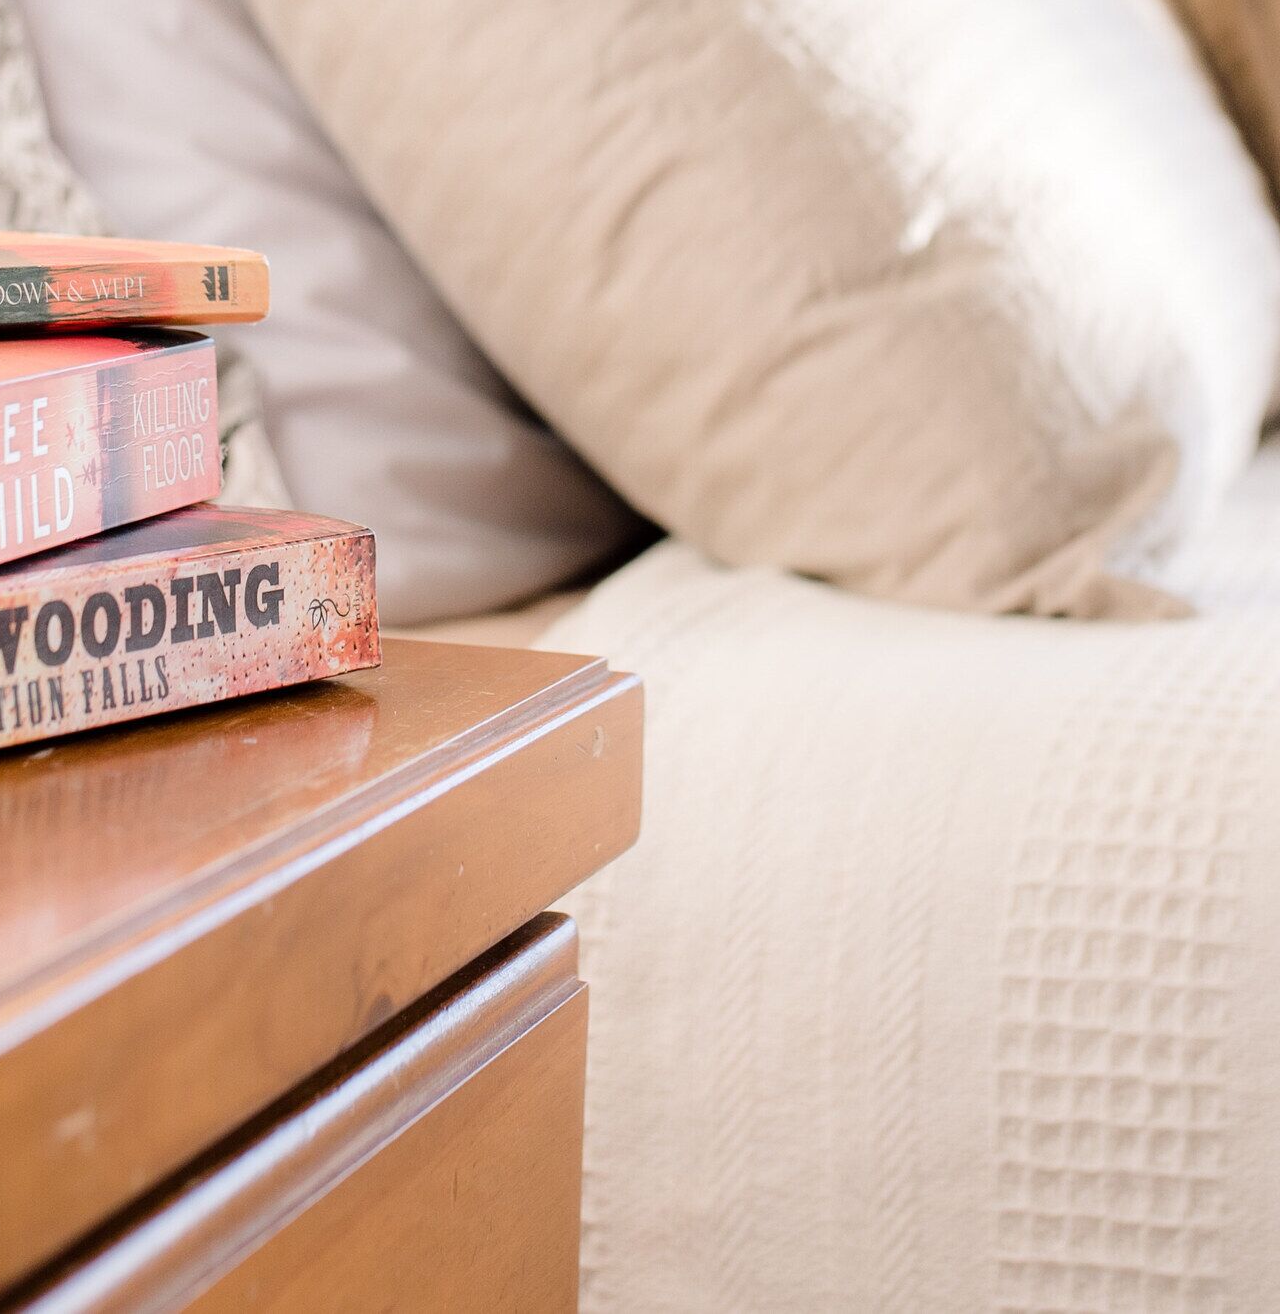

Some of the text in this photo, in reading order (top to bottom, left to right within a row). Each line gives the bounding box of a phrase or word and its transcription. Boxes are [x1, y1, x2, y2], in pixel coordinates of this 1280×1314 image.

[66, 280, 84, 302] &
[91, 276, 147, 300] WEPT
[133, 377, 210, 438] KILLING
[142, 432, 206, 491] FLOOR
[81, 654, 169, 714] FALLS
